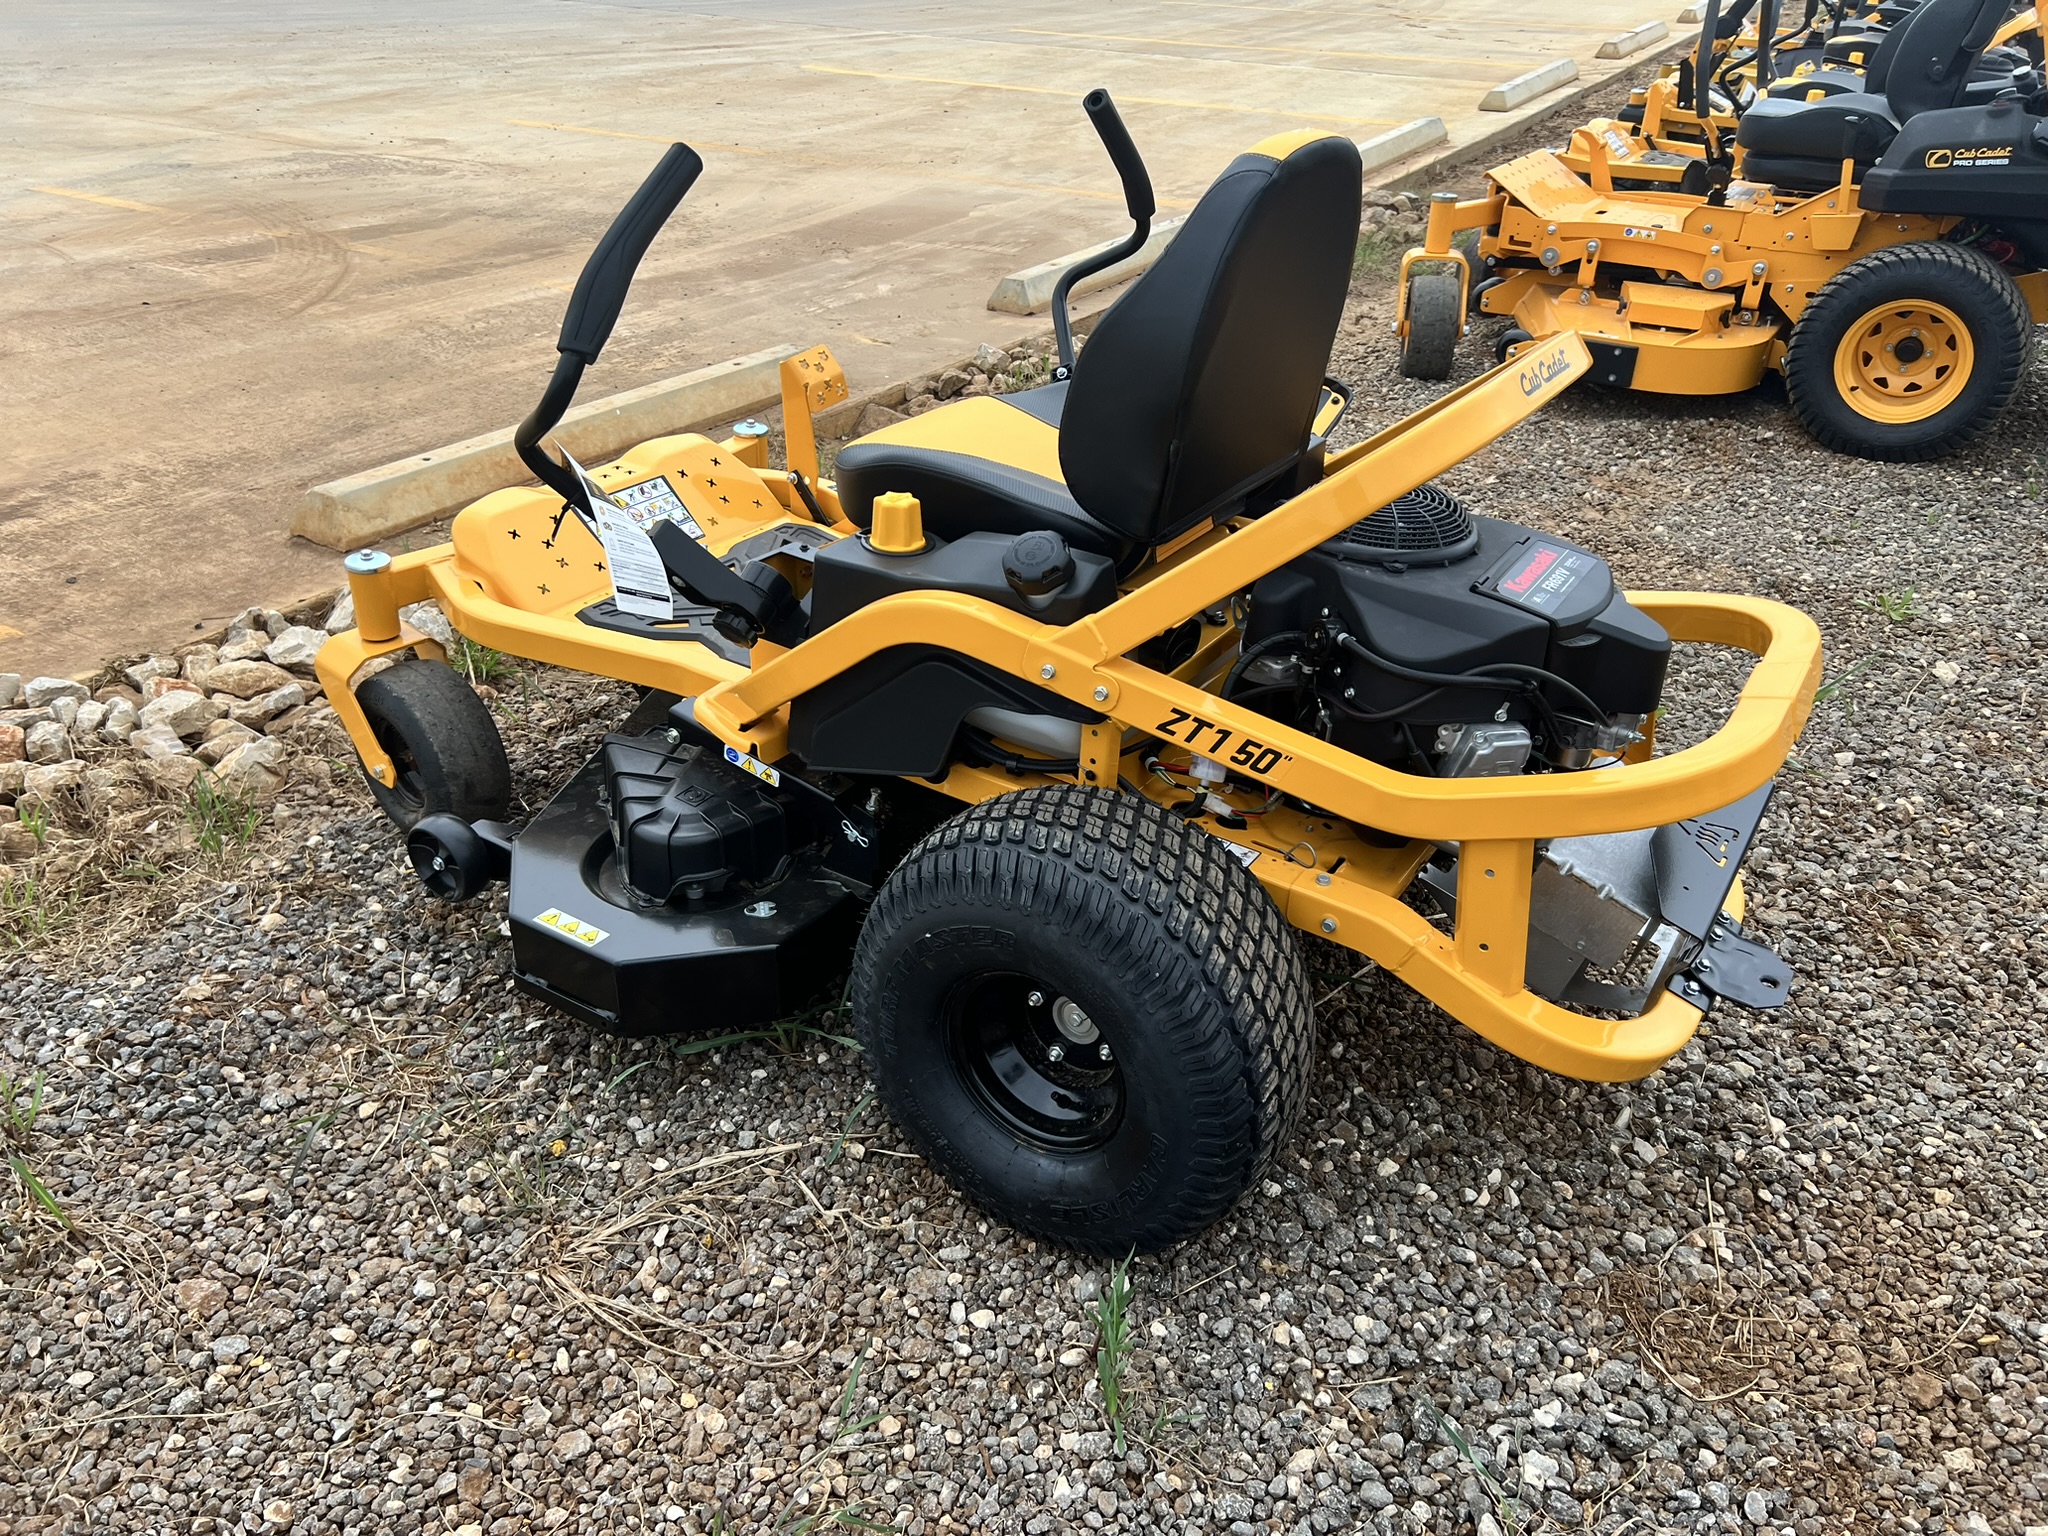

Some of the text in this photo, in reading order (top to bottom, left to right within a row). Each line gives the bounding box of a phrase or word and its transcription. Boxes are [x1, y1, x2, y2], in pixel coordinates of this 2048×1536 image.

[1955, 146, 2013, 158] Cub Cadet
[1520, 347, 1571, 397] Cub Cadet
[1503, 547, 1559, 593] Kawasaki
[1541, 566, 1571, 593] FR691V
[1155, 707, 1233, 755] ZT1
[893, 924, 1017, 978] MASTER
[1049, 1131, 1170, 1226] CARLISLE
